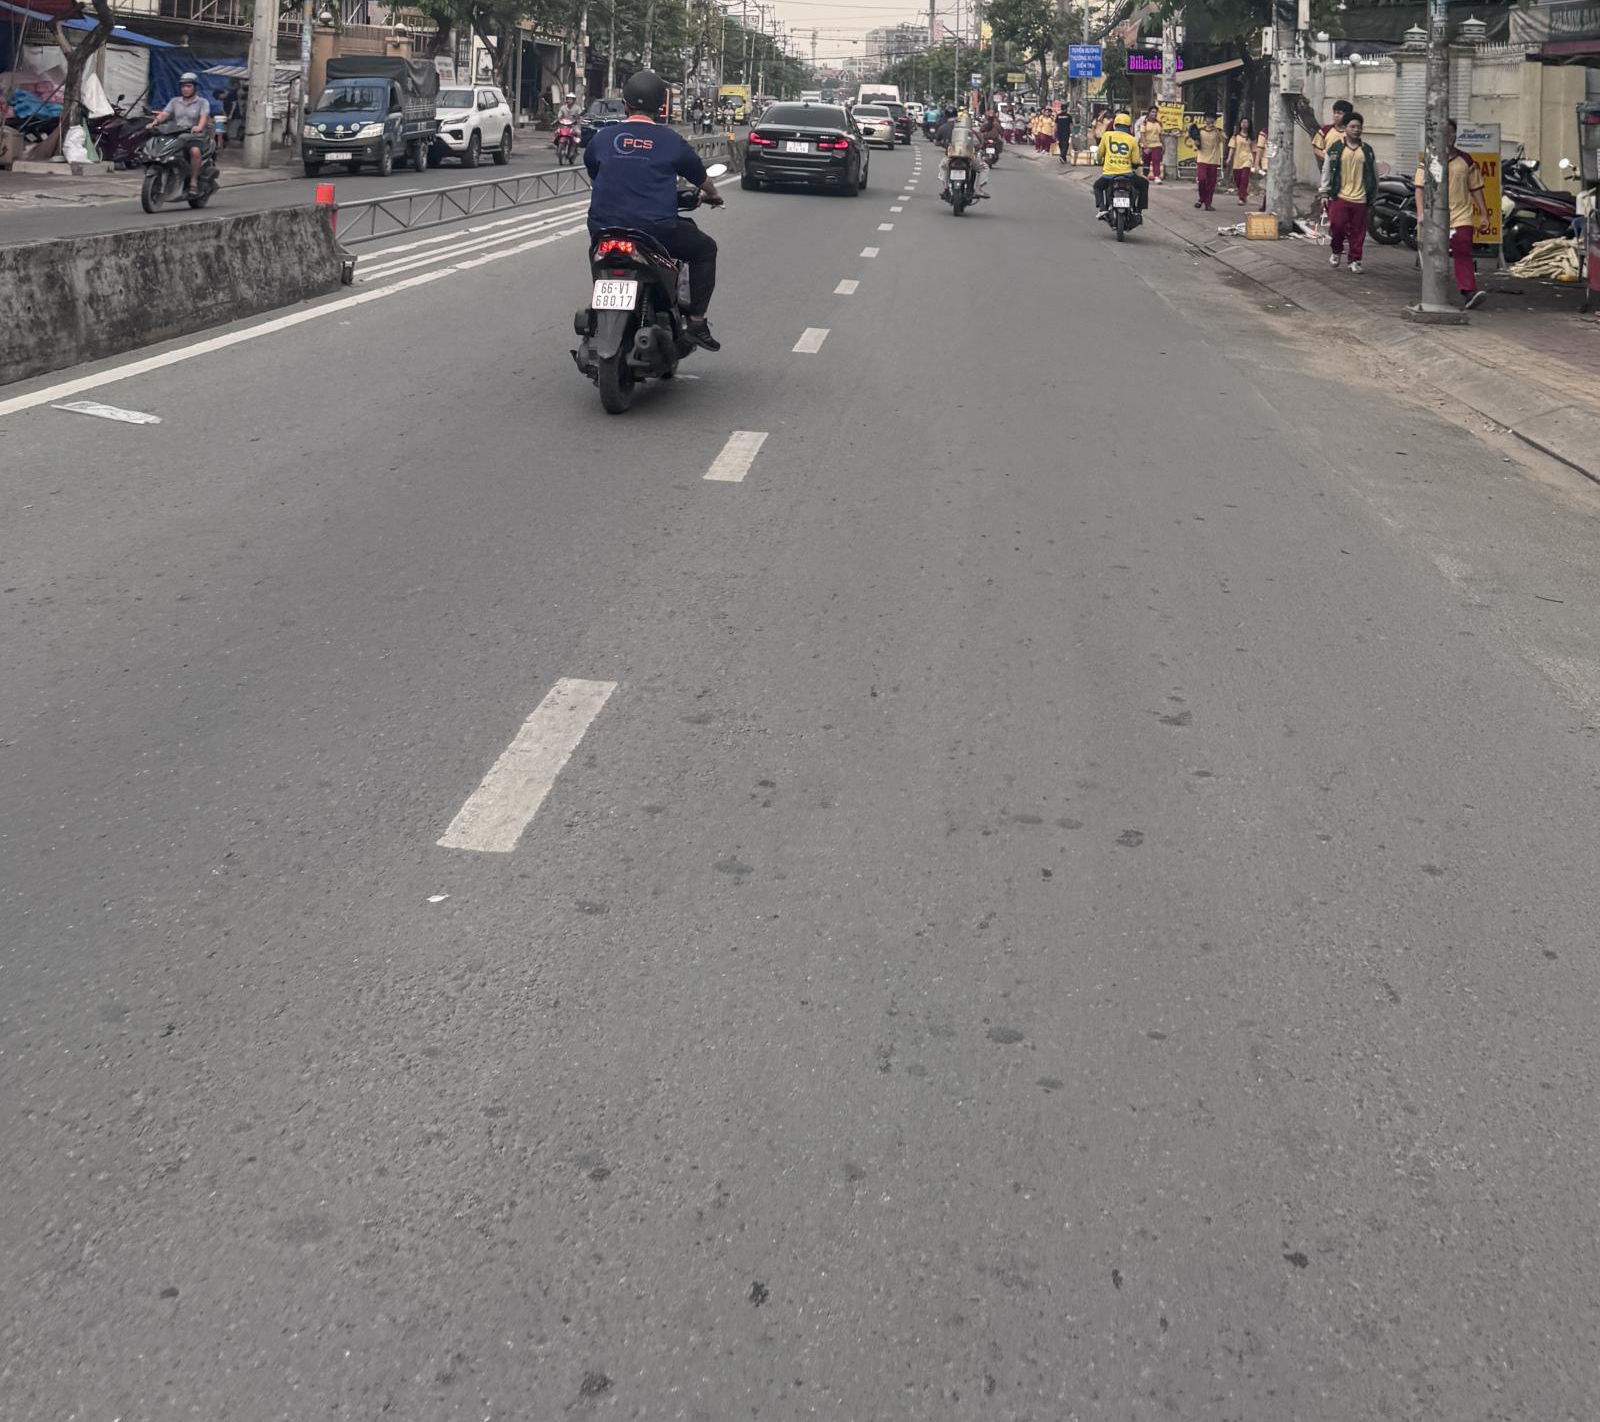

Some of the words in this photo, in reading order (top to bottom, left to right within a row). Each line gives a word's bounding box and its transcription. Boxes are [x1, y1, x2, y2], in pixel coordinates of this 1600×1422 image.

[1129, 55, 1162, 70] Billards
[623, 138, 654, 149] PCS
[1109, 135, 1130, 155] be
[601, 282, 630, 294] 66-V1
[595, 295, 633, 306] 680.17
